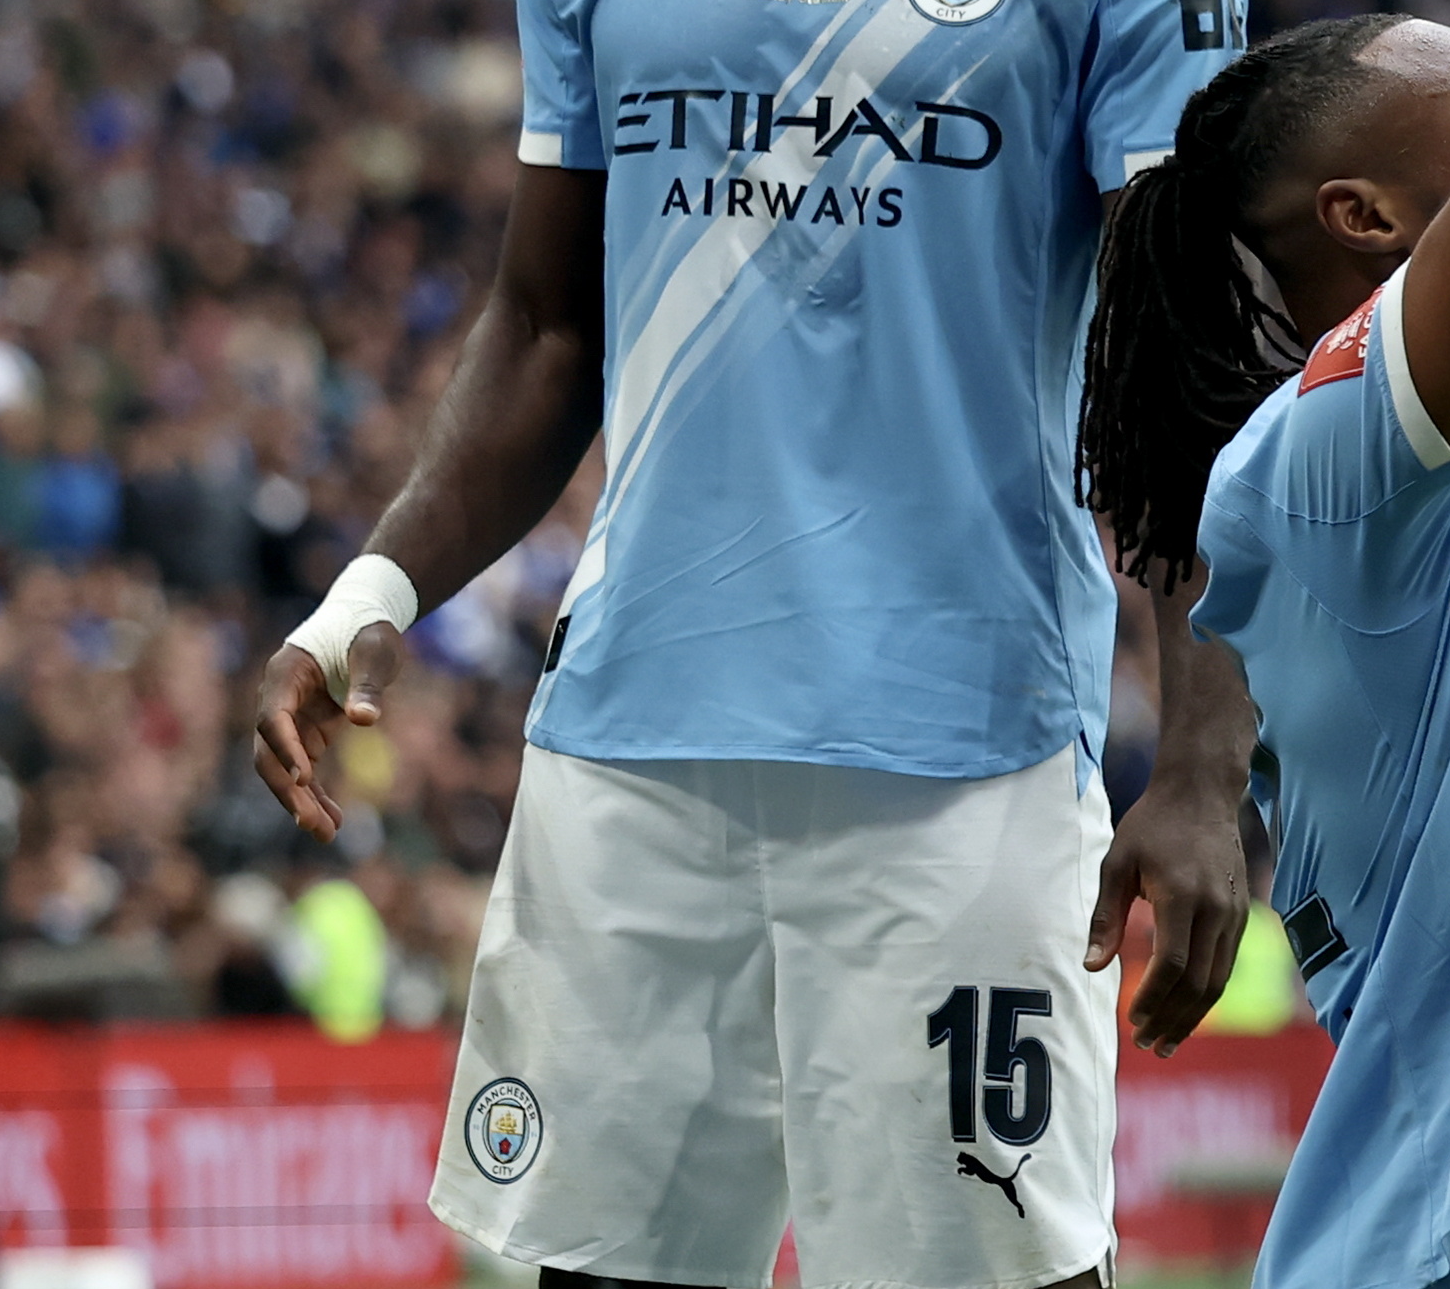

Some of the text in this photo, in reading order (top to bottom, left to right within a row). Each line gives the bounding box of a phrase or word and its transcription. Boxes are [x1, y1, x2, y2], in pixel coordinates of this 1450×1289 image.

[936, 7, 967, 20] CITY
[614, 89, 1003, 171] ETIHAD
[660, 177, 904, 228] AIRWAYS
[926, 985, 1053, 1147] 15
[476, 1085, 537, 1121] MANCHESTER
[491, 1164, 515, 1177] CITY
